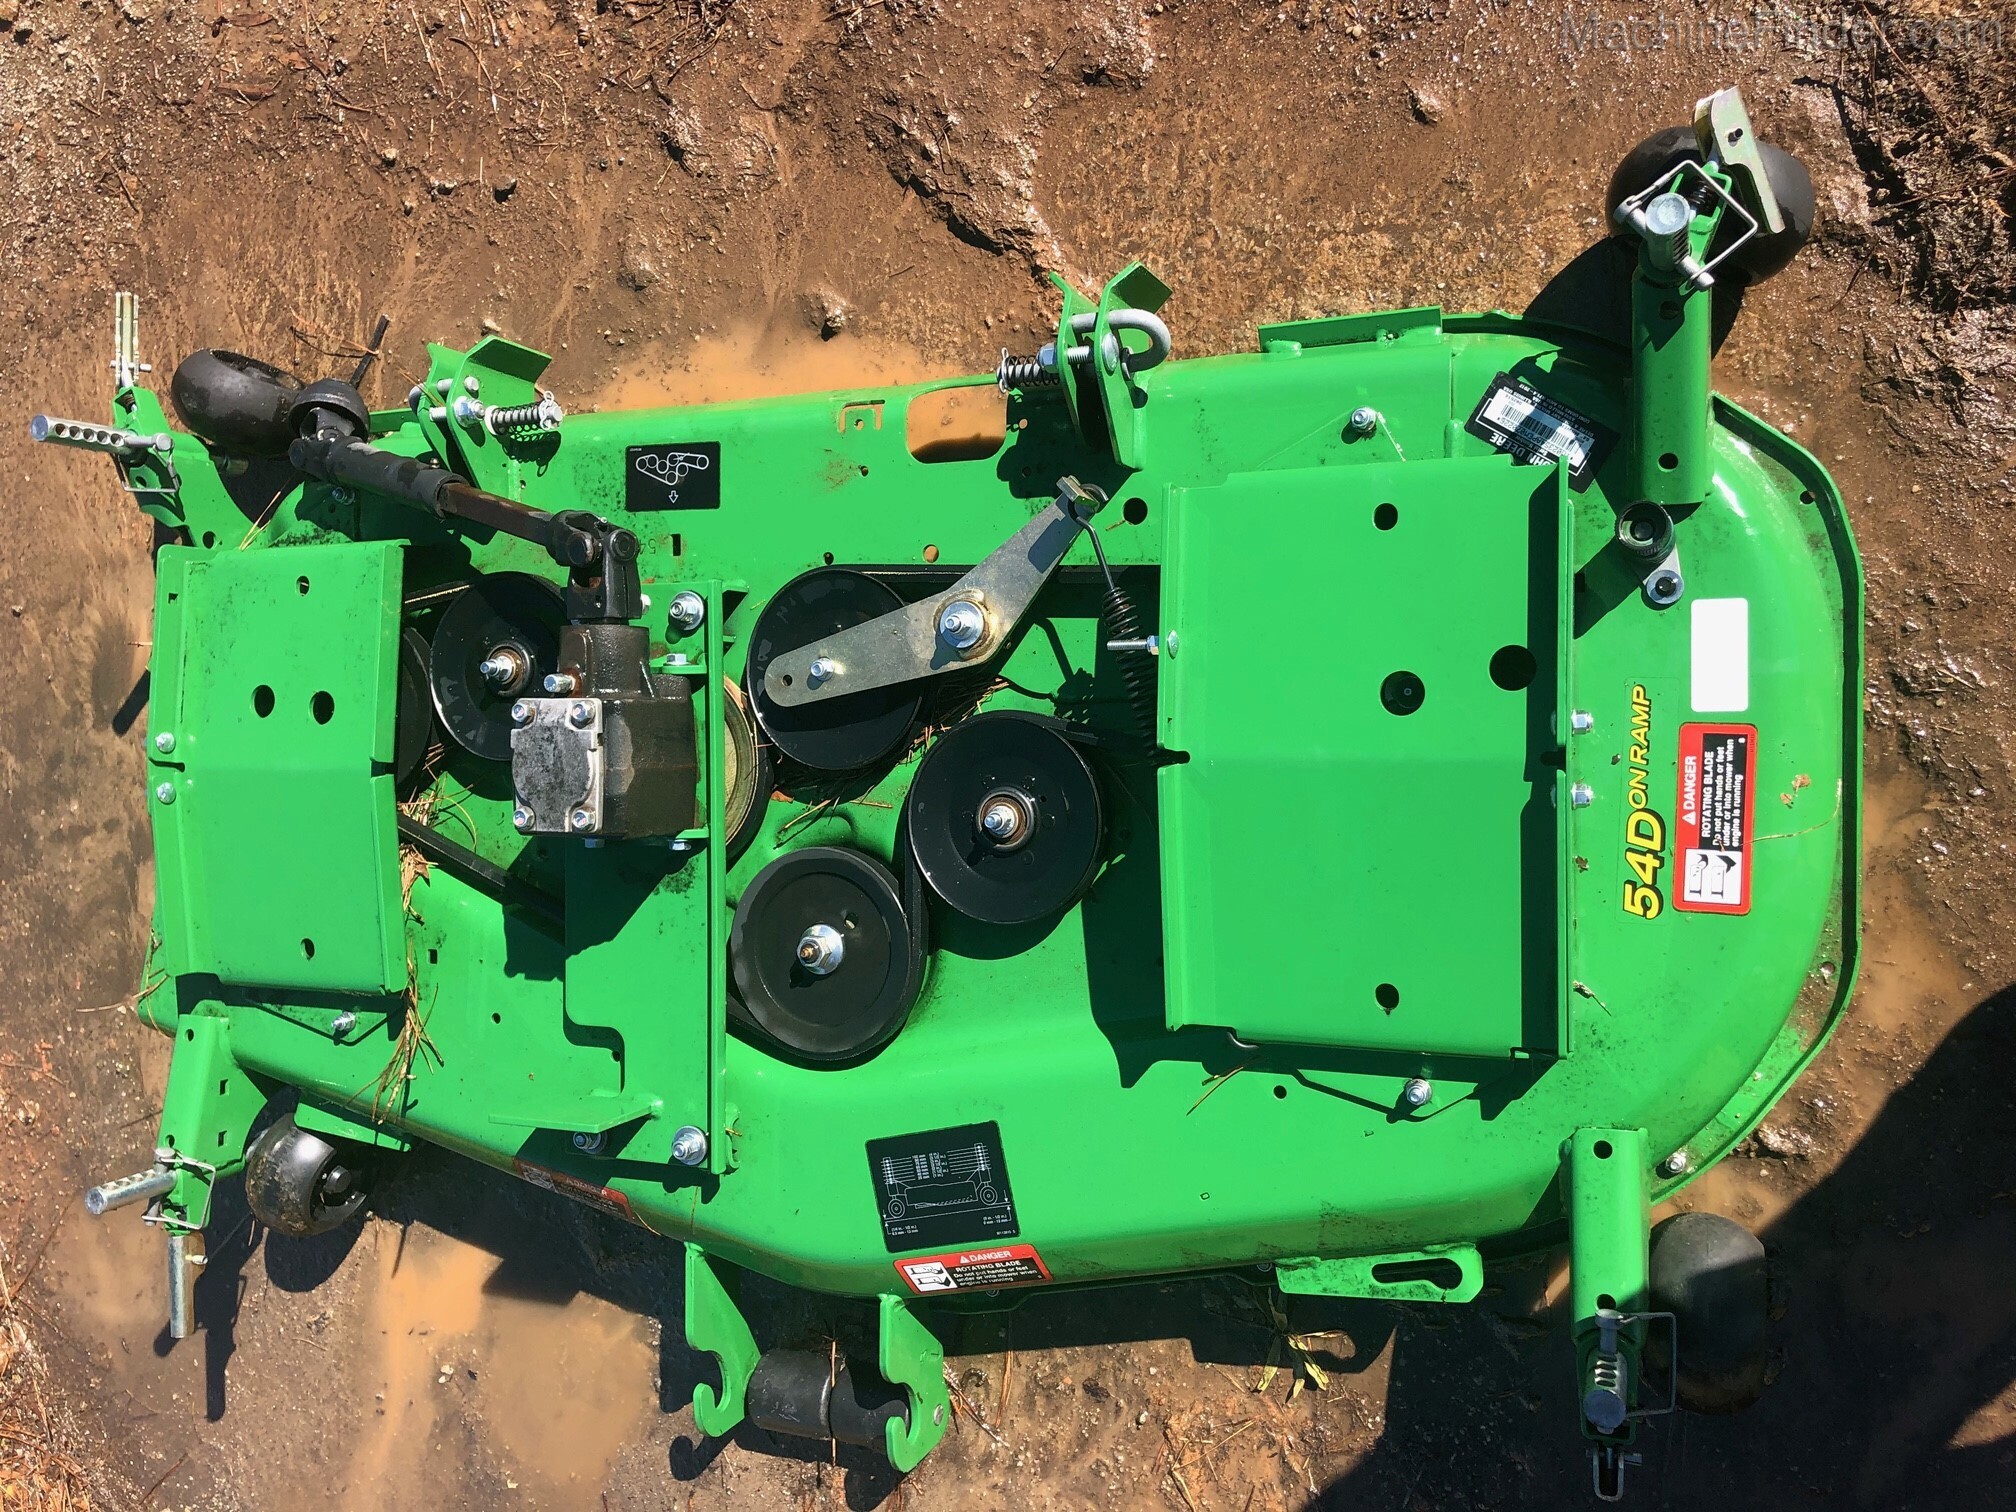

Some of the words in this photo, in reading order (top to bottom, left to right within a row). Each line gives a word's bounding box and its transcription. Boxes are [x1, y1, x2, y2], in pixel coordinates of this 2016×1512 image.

[1629, 684, 1652, 765] RAMP
[1716, 746, 1724, 762] feet
[1725, 739, 1734, 761] when
[1704, 751, 1714, 784] BLADE
[1717, 764, 1724, 774] or
[1725, 763, 1733, 791] mower
[1627, 766, 1650, 810] ON
[1683, 756, 1697, 810] DANGER
[1714, 775, 1723, 800] hands
[1733, 774, 1743, 807] running
[1702, 786, 1712, 837] ROTATING
[1715, 802, 1723, 816] put
[1723, 792, 1732, 809] into
[1724, 811, 1731, 820] or
[1712, 834, 1721, 846] Do
[1722, 822, 1730, 846] under
[1732, 818, 1741, 847] engine
[1622, 808, 1666, 920] 54D
[956, 1263, 994, 1272] ROTATING
[995, 1260, 1021, 1268] BLADE
[969, 1250, 1012, 1262] DANGER
